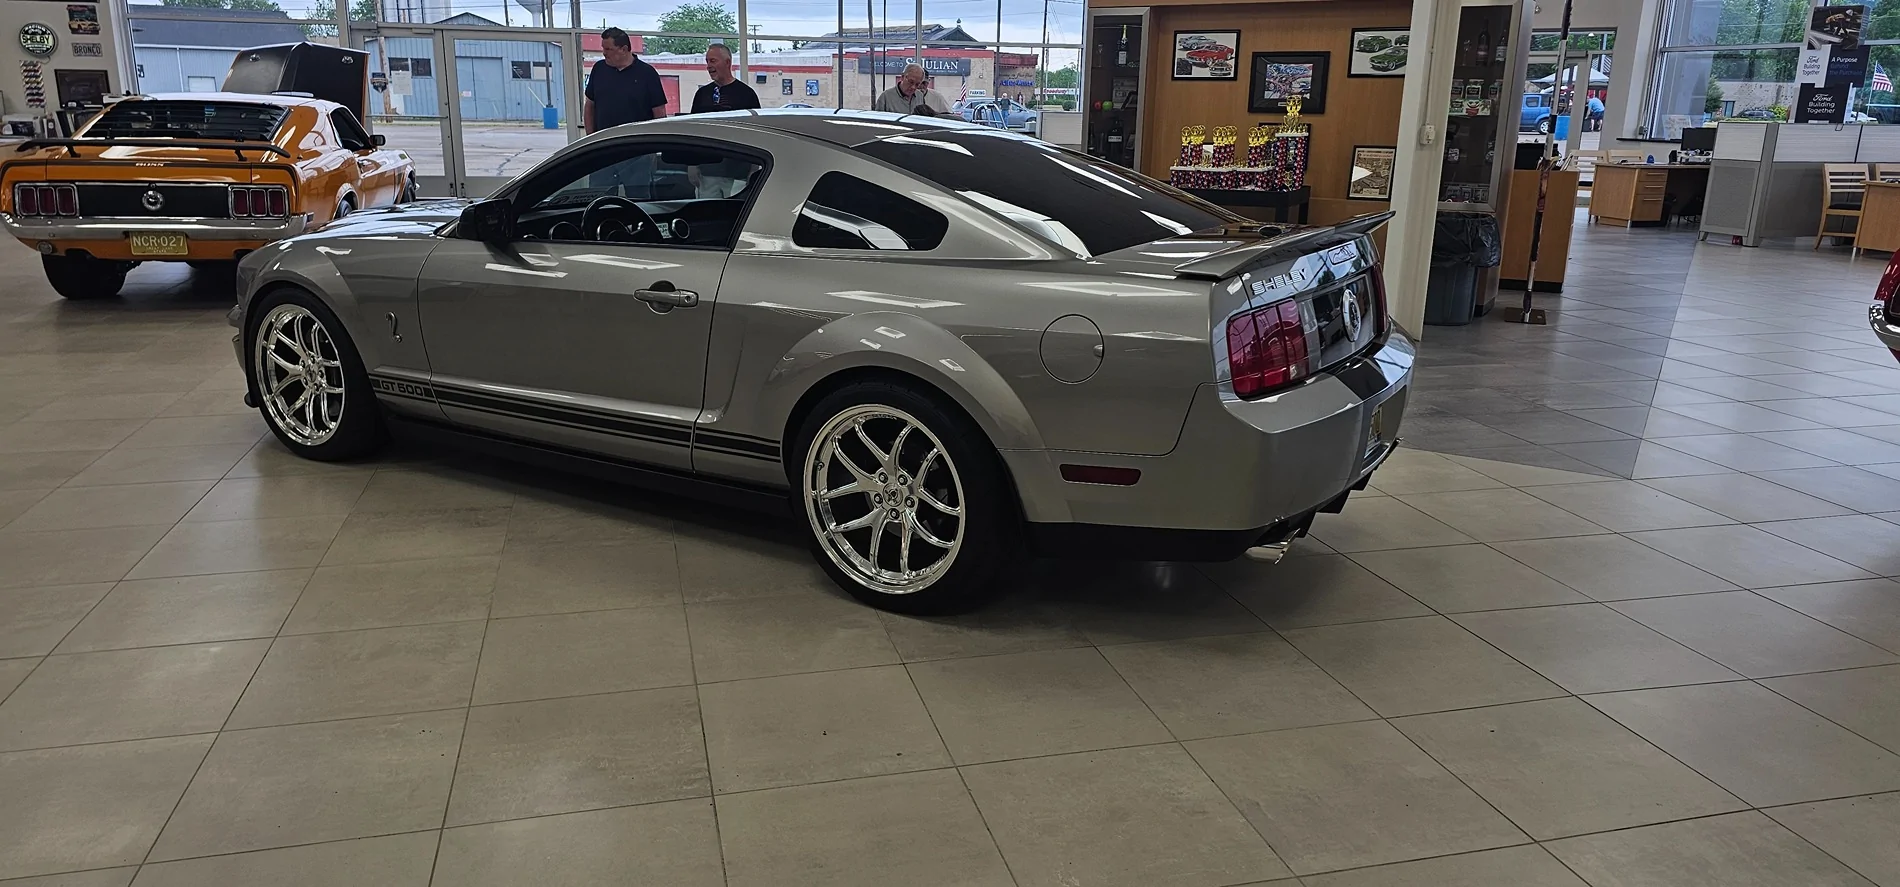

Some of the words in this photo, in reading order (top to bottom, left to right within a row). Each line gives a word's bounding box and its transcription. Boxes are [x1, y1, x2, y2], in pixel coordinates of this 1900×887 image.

[22, 34, 50, 44] SHELBY
[74, 45, 101, 55] BRONCO
[921, 57, 958, 70] JULIAN
[1812, 94, 1833, 102] Ford
[1251, 267, 1308, 296] SHELBY
[381, 380, 396, 391] GT
[397, 382, 424, 396] 500
